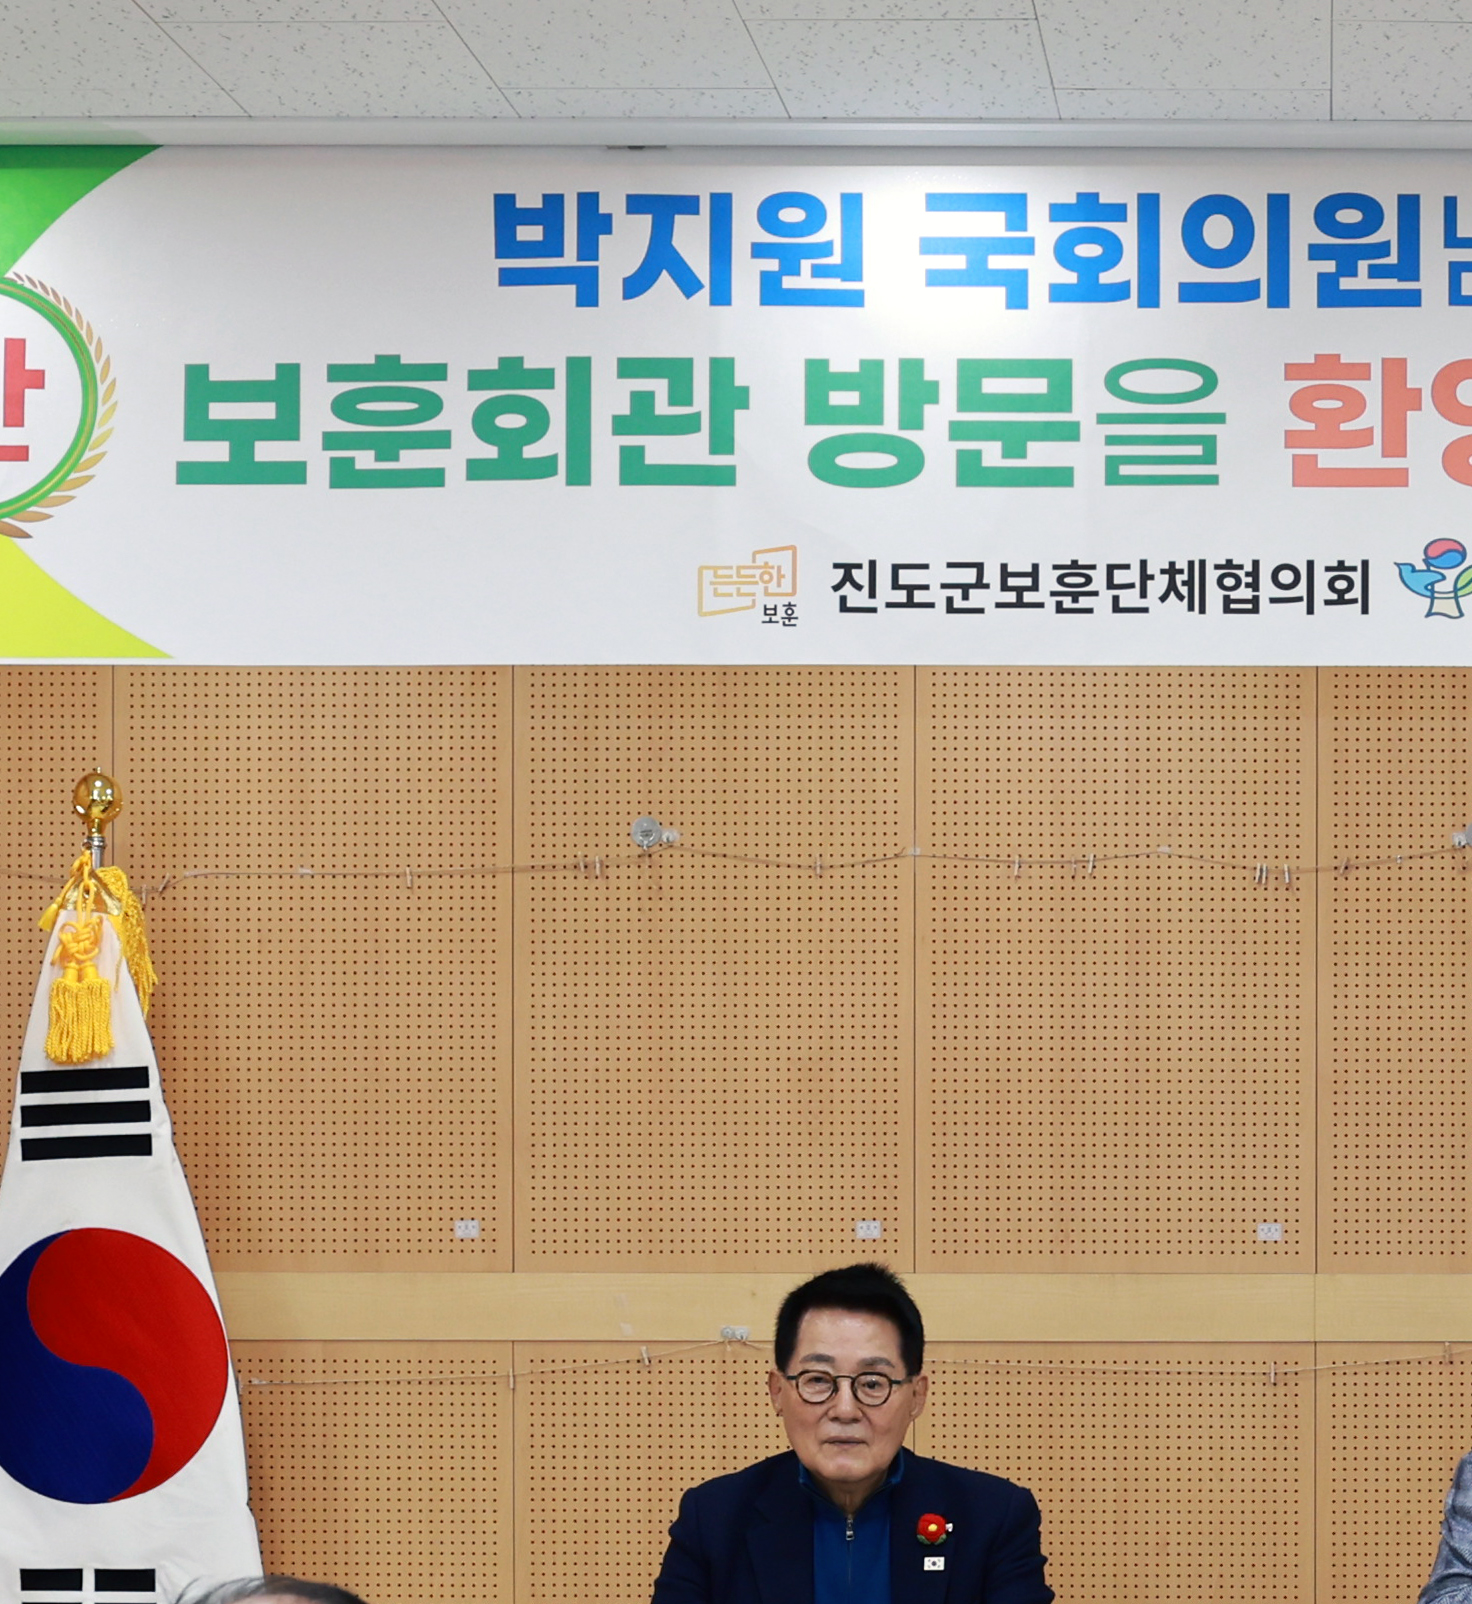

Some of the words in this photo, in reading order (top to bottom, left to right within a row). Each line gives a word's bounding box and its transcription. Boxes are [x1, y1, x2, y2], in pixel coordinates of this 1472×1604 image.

[493, 191, 867, 309] 박지원
[176, 354, 751, 489] 보훈회관
[804, 356, 1227, 488] 방문을
[705, 557, 796, 600] 든든한
[830, 557, 1371, 616] 진도군보훈단체협의회
[761, 601, 799, 627] 보훈
